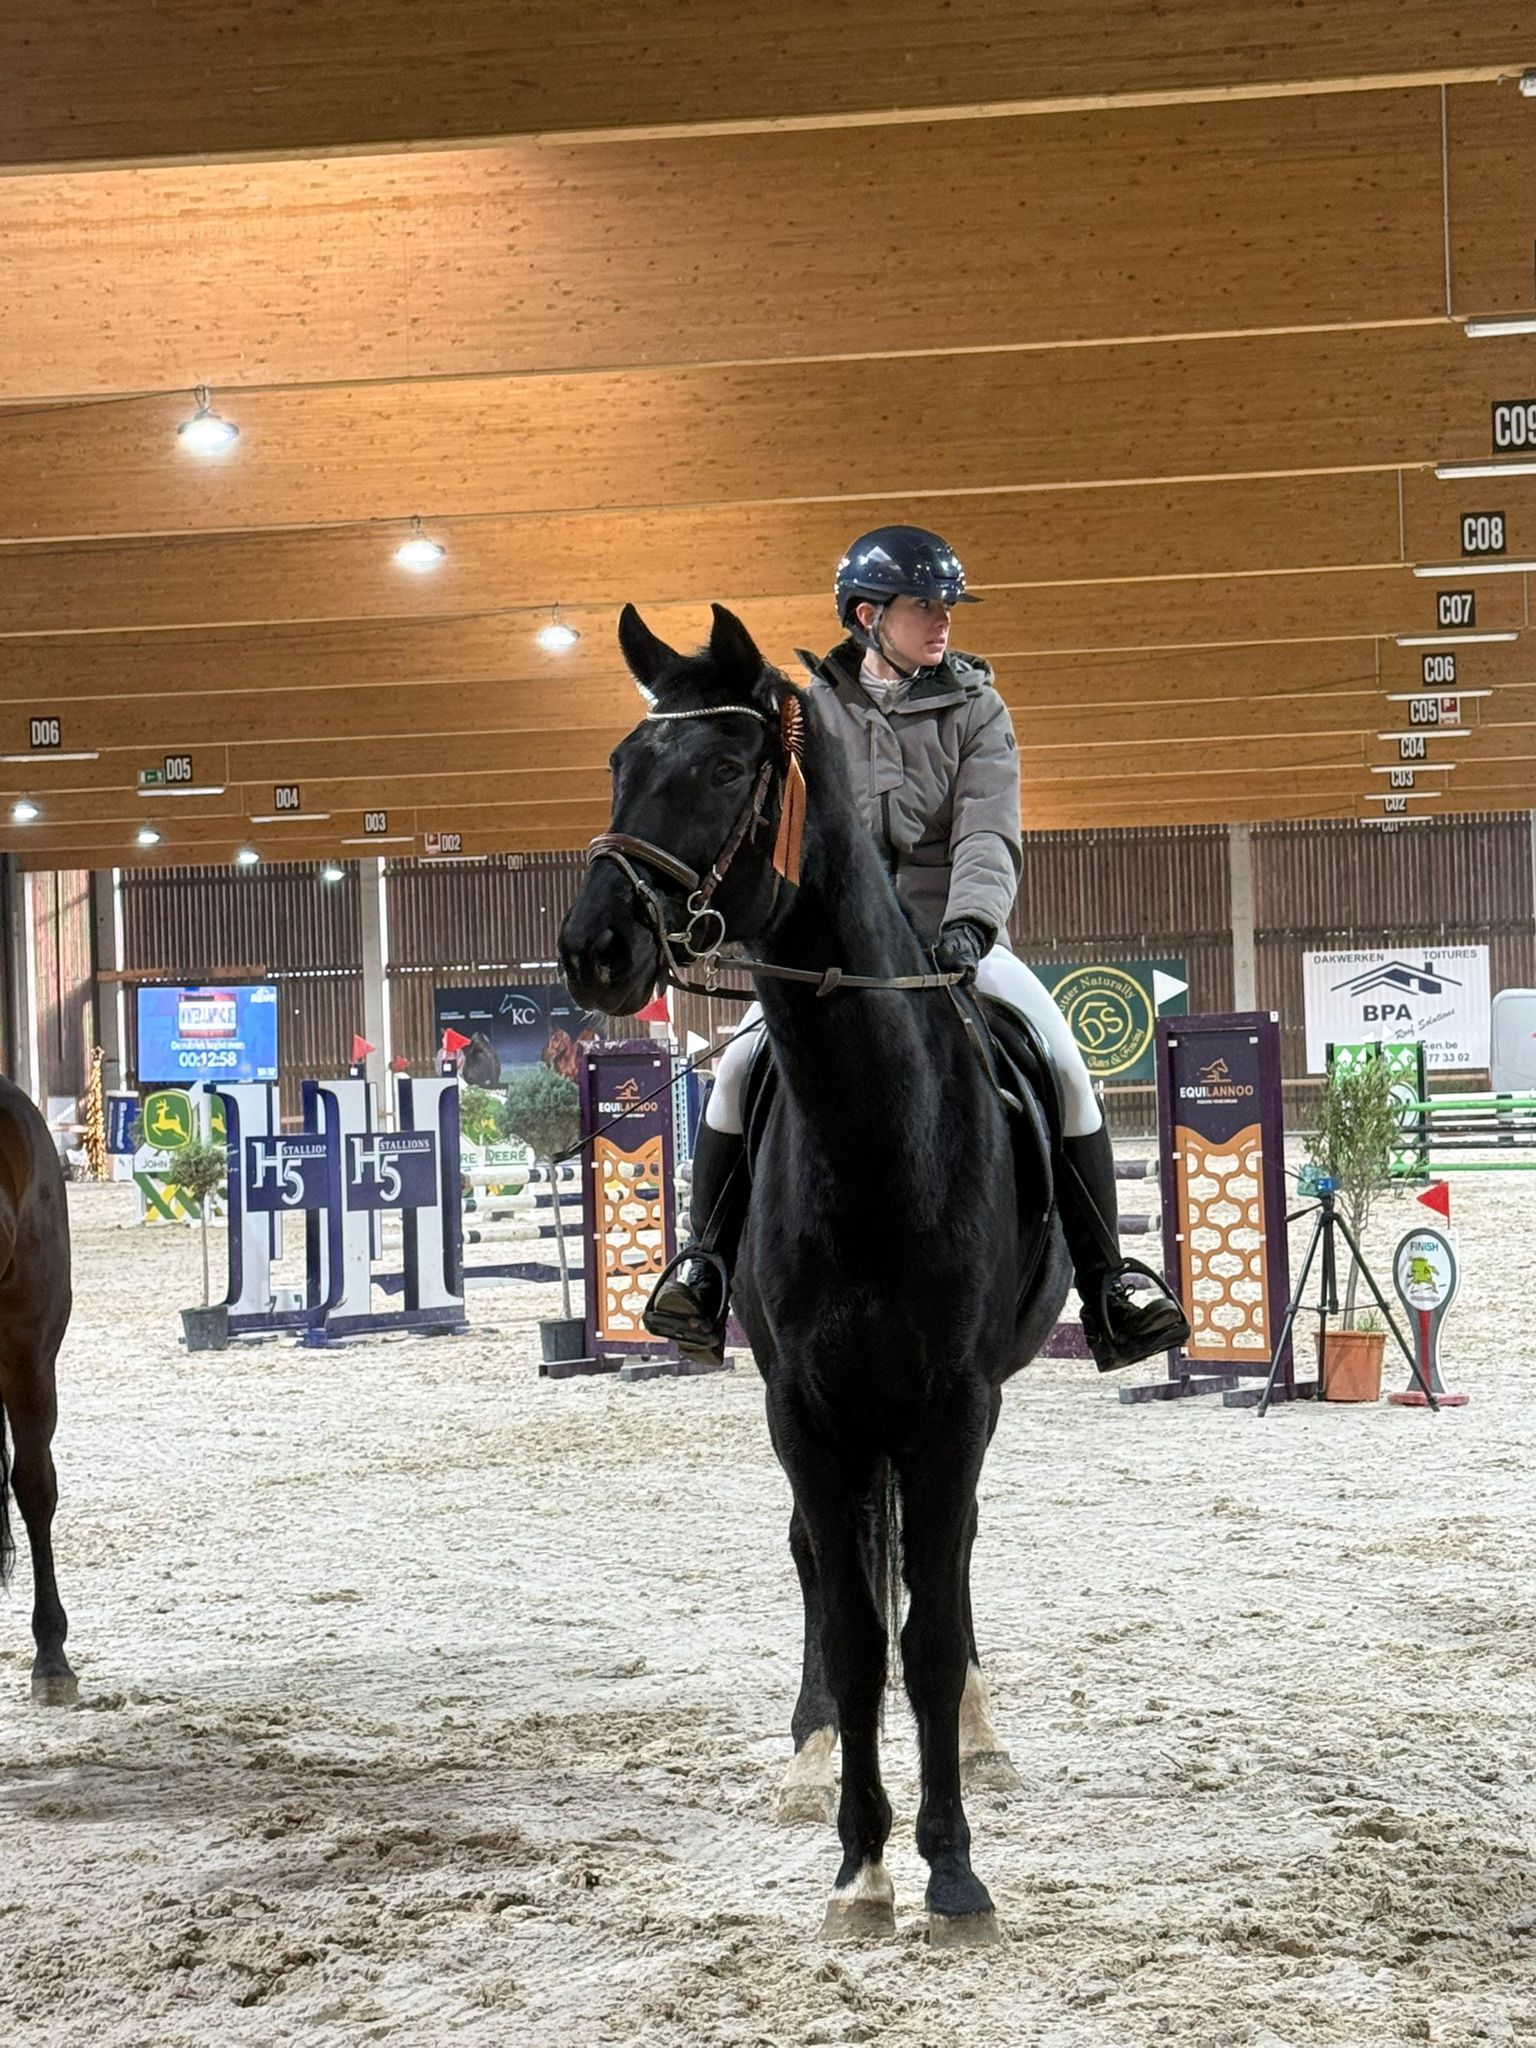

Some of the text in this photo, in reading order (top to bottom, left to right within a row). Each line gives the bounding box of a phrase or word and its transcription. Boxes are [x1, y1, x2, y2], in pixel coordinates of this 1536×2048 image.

[1494, 405, 1536, 446] C09
[1463, 516, 1504, 550] C08
[1439, 594, 1473, 624] C07
[1424, 656, 1454, 683] C06
[1410, 700, 1437, 723] C05
[31, 720, 59, 745] D06
[1400, 737, 1425, 758] C04
[166, 758, 190, 781] D05
[275, 788, 298, 809] D04
[365, 813, 386, 831] D03
[441, 834, 461, 850] D02
[1313, 953, 1384, 964] DAKWERKEN
[1423, 949, 1477, 959] TOITURES
[1080, 976, 1136, 999] Naturally
[512, 1009, 536, 1025] KC
[1363, 1004, 1412, 1022] BPA
[1395, 1008, 1455, 1040] Roof Solutions
[179, 1052, 238, 1068] 00:12:58
[1428, 1053, 1470, 1063] 77 33 02
[1180, 1085, 1254, 1098] EQUILANNOO
[380, 1139, 430, 1150] STALLIONS
[485, 1148, 527, 1161] DEERE
[142, 1160, 168, 1169] JOHN
[1410, 1242, 1438, 1251] FINISH
